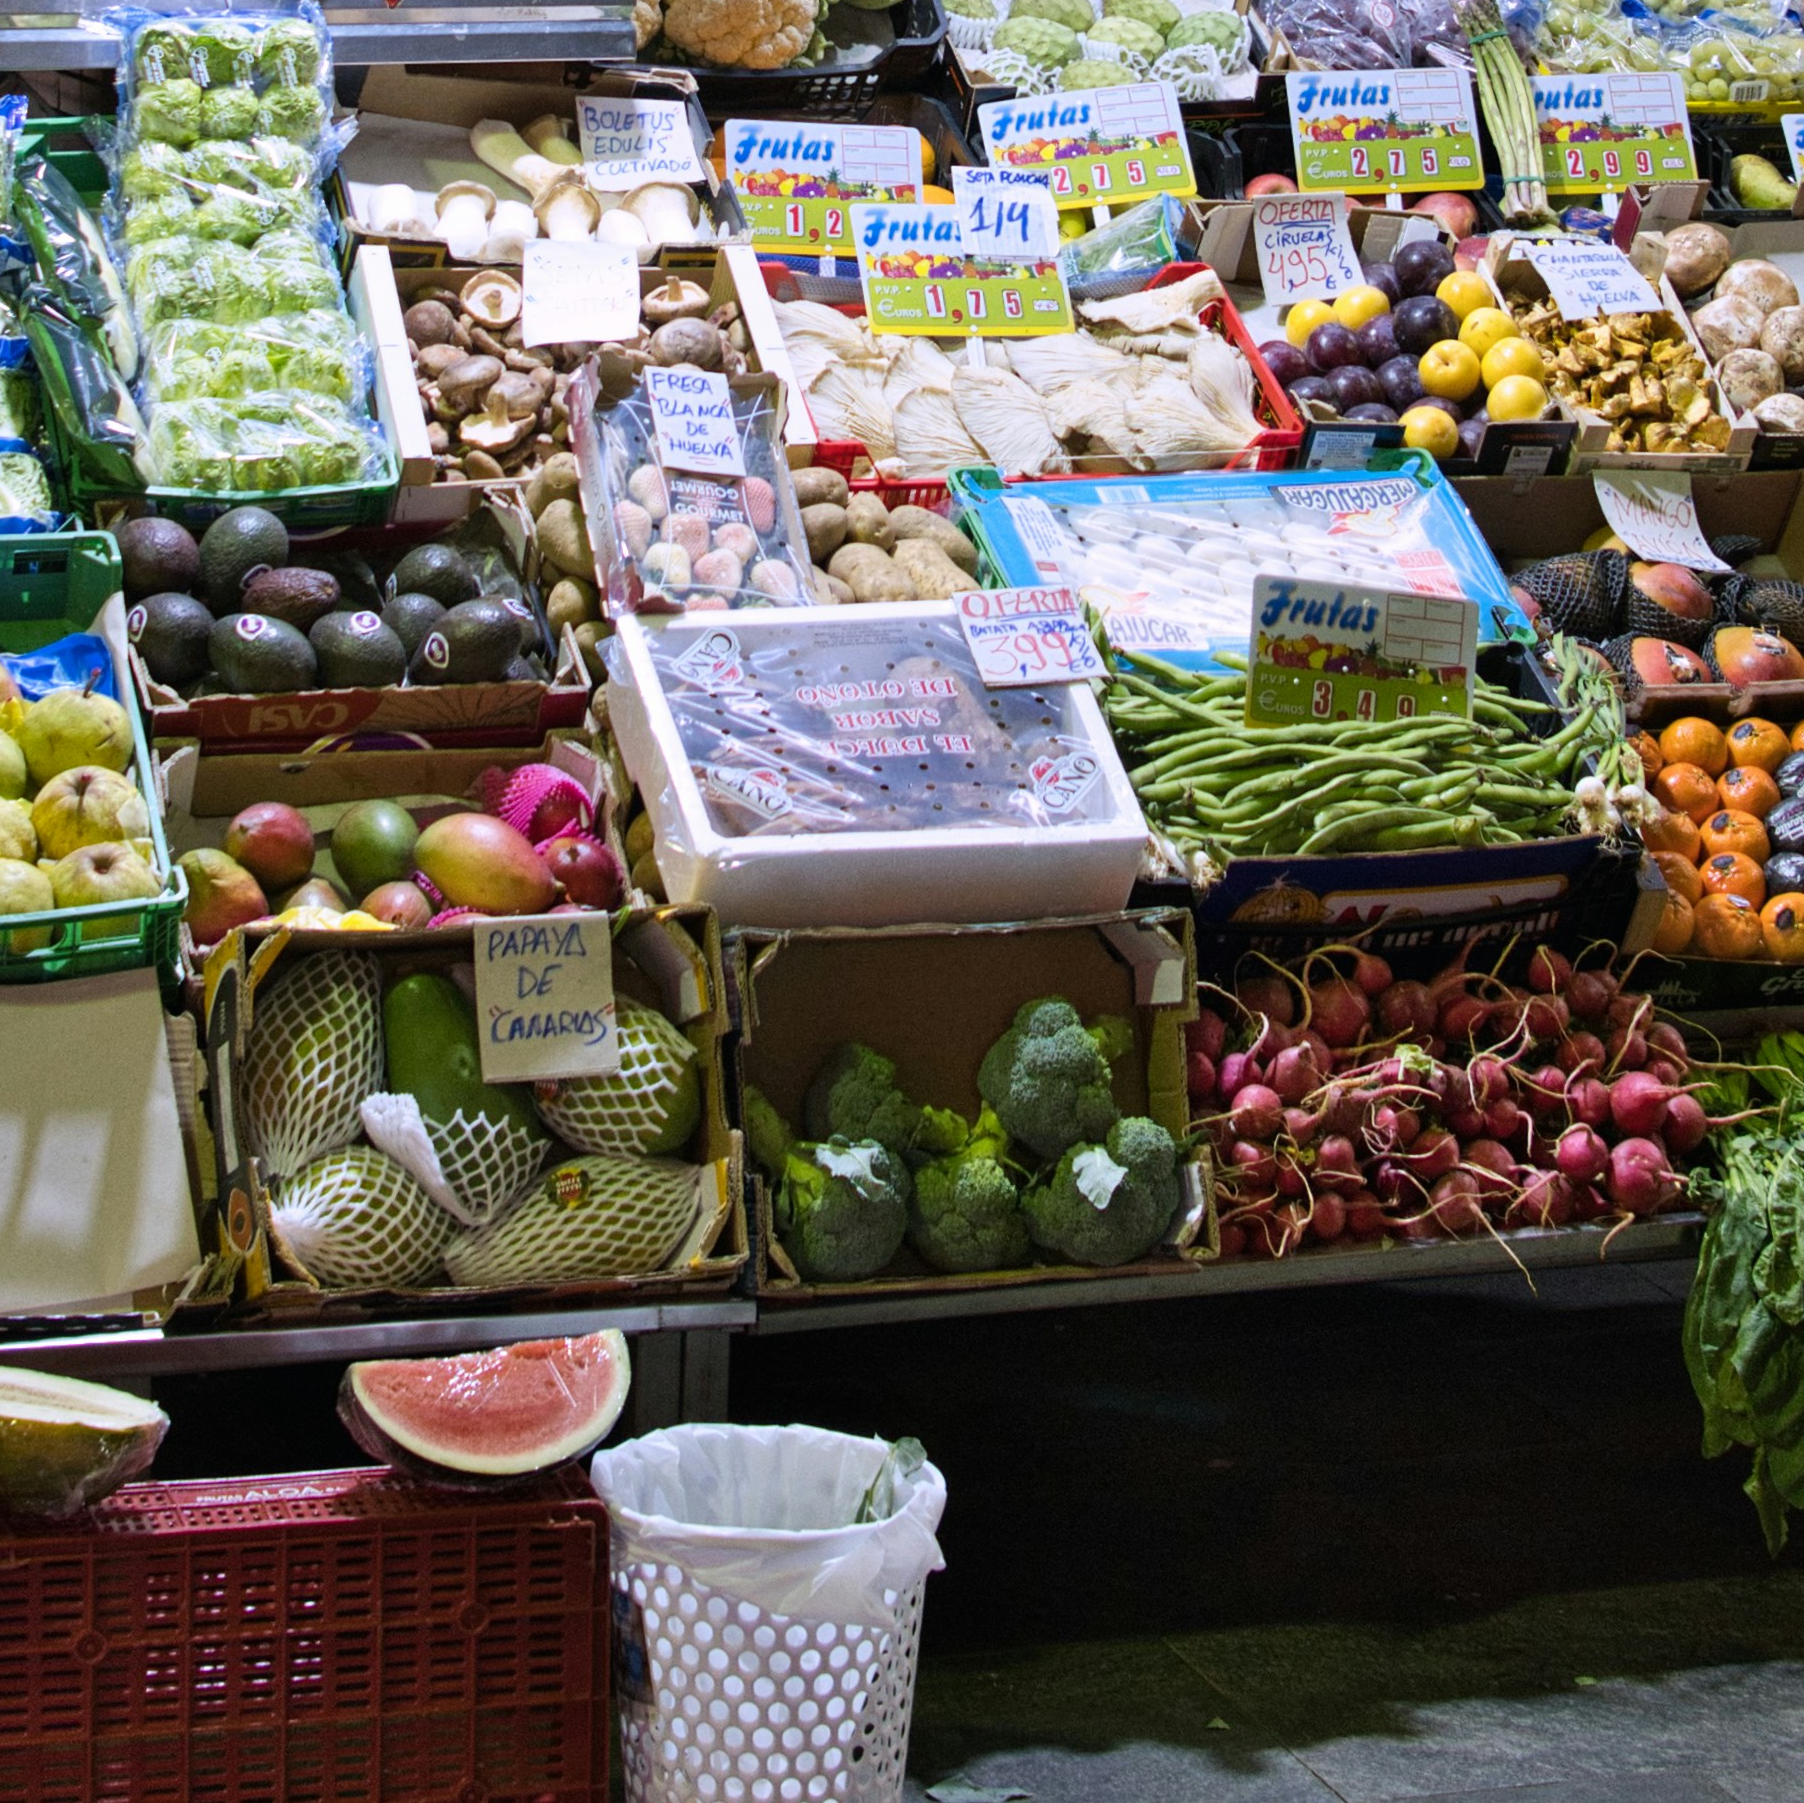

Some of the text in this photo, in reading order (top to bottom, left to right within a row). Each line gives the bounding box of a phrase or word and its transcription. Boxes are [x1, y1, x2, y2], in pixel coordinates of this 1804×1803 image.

[1296, 72, 1392, 114] Frutas
[1533, 80, 1604, 112] rutas
[991, 99, 1092, 141] Frutas
[734, 124, 835, 165] Frutas
[965, 169, 996, 185] SETA
[969, 195, 1030, 242] 1/4
[1258, 198, 1336, 227] OFERTA
[1263, 228, 1336, 251] CIRUELAS
[1268, 245, 1329, 294] 4,95
[1587, 280, 1609, 292] DE
[651, 372, 713, 396] FRESA
[686, 420, 710, 438] DE
[670, 479, 740, 500] GOURMET
[1279, 479, 1417, 508] MERCAJUCAR
[675, 501, 745, 523] GOURMET
[961, 587, 1076, 619] OFERTA
[1260, 577, 1382, 635] Frutas
[1107, 616, 1193, 646] AJUCAR
[979, 630, 1077, 678] 3,99
[910, 678, 959, 699] DE
[834, 707, 943, 732] SABOR
[931, 734, 975, 753] EL
[488, 920, 588, 962] PAPAYA
[517, 963, 563, 999] DE
